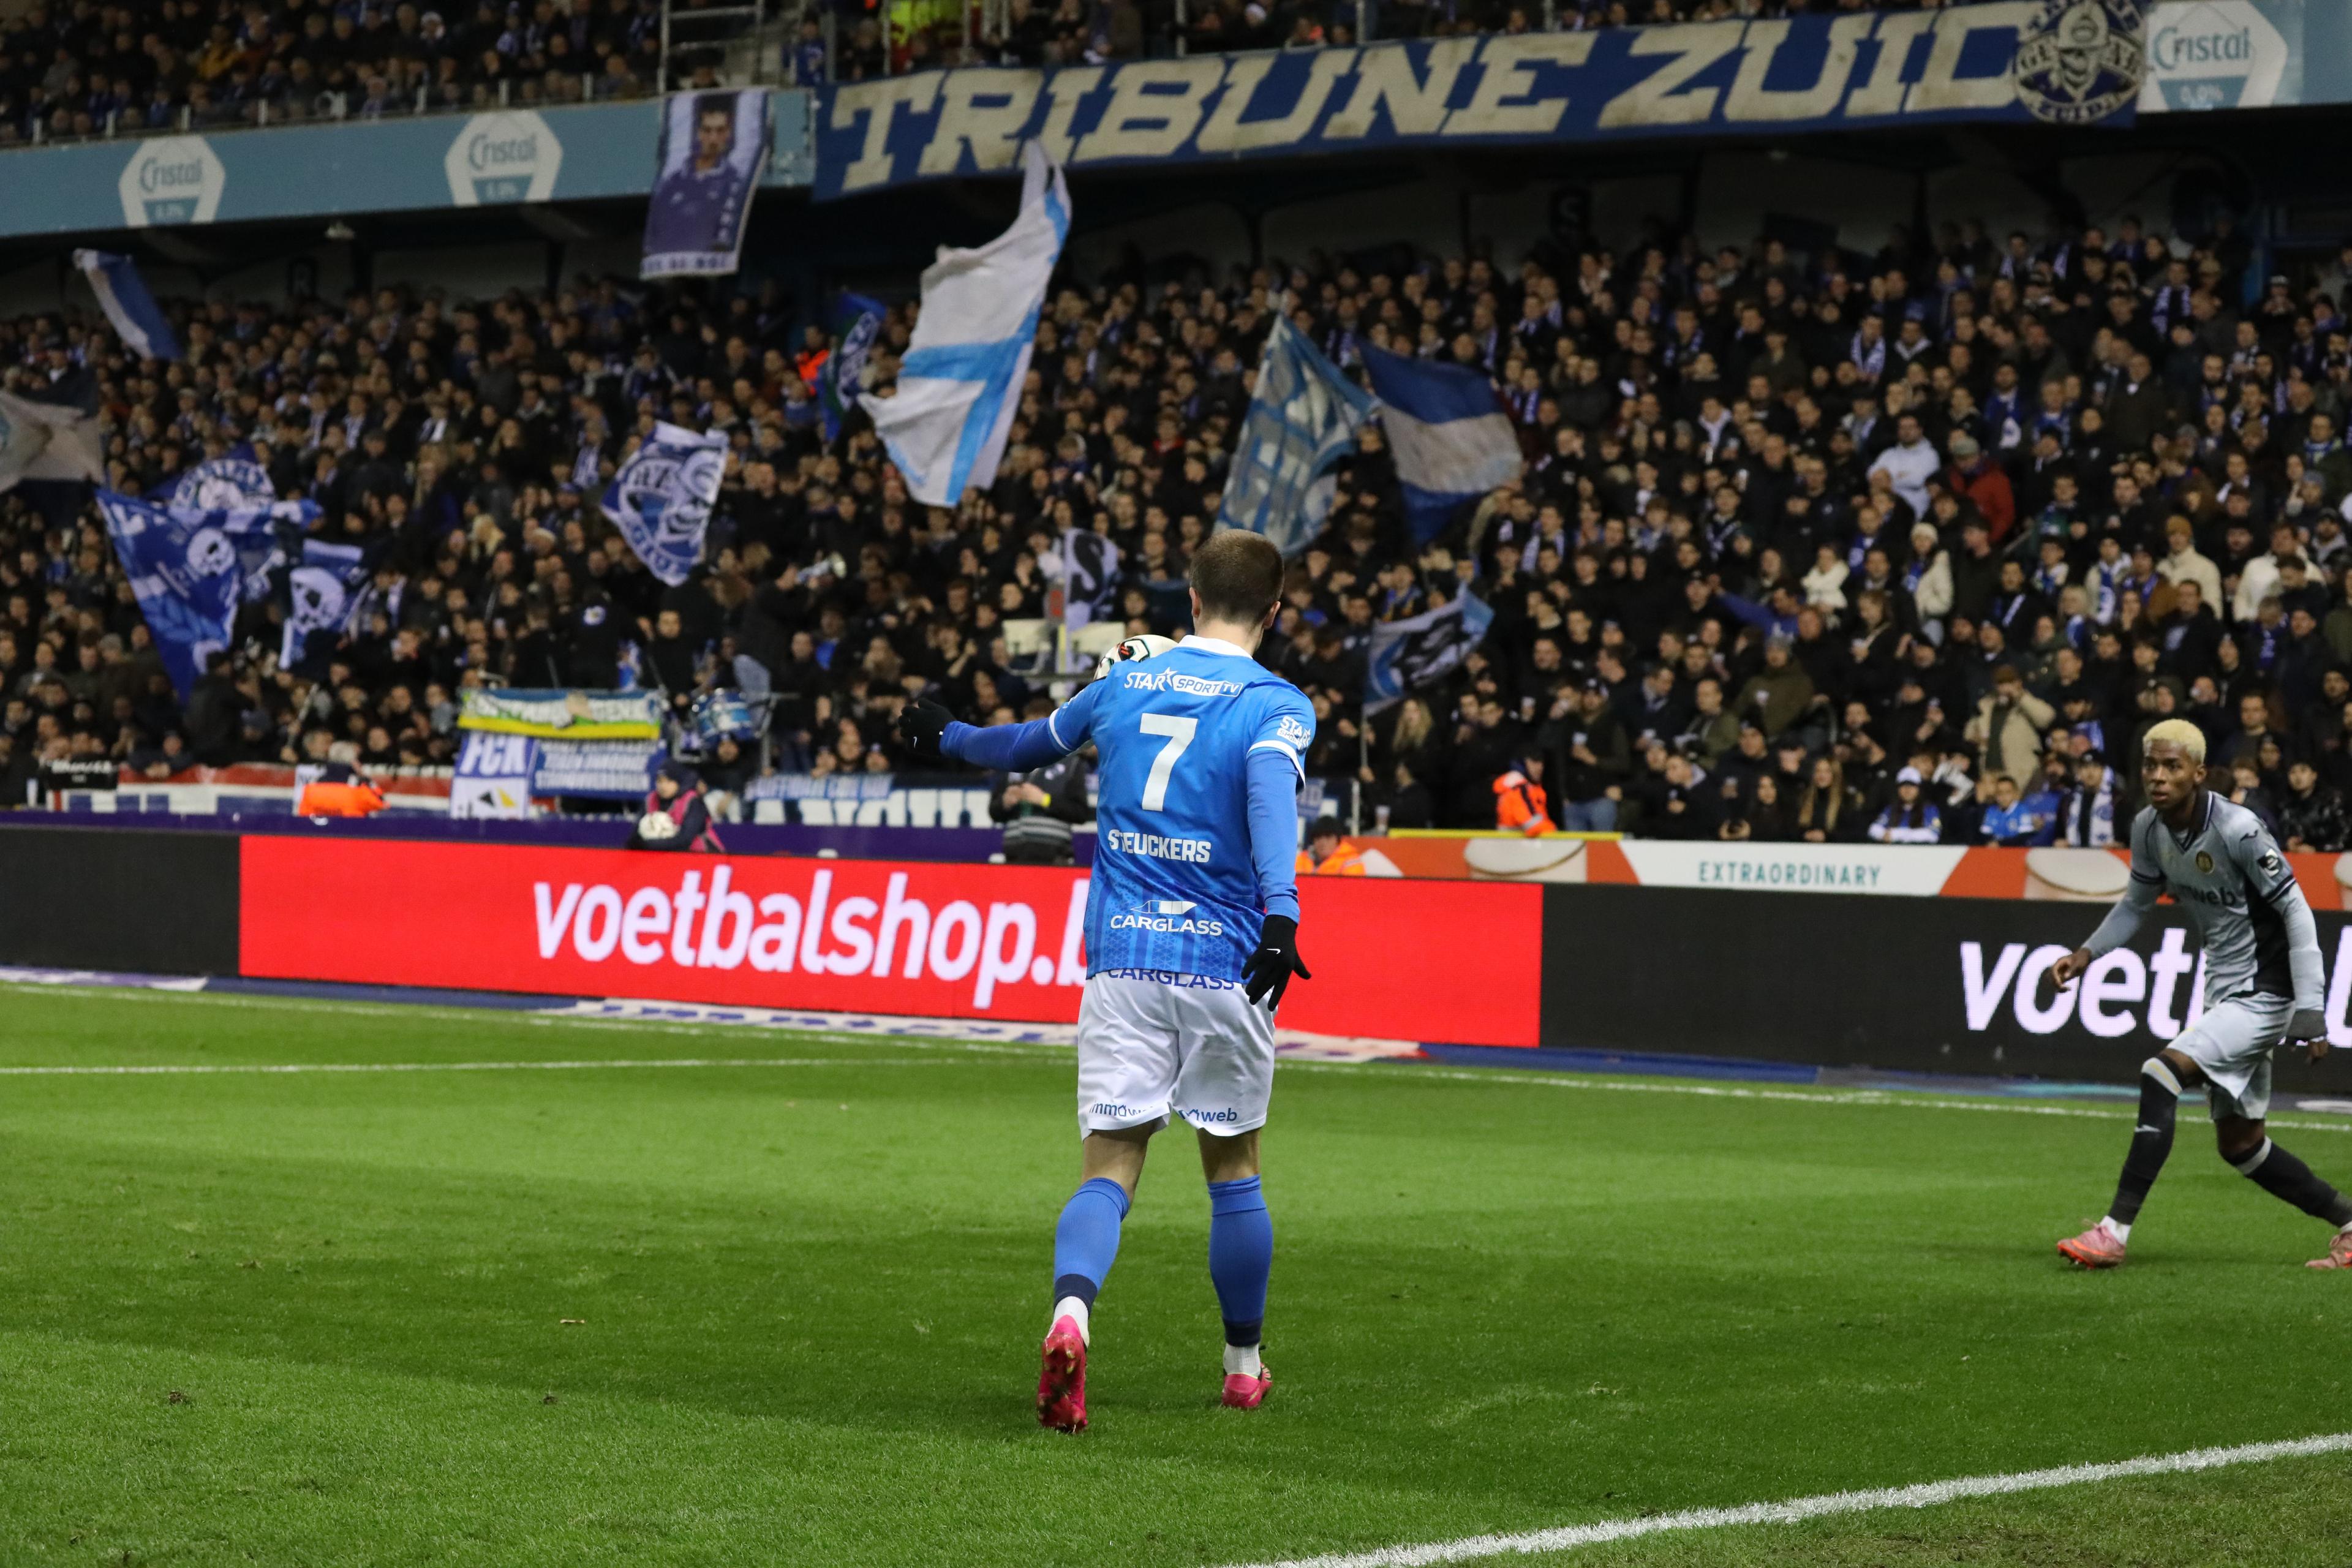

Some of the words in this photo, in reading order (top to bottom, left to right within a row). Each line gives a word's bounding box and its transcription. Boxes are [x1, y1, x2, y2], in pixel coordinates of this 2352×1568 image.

[2152, 26, 2250, 70] Cristal
[832, 31, 1599, 192] TRIBUNE
[1597, 2, 2043, 129] ZUID
[469, 132, 538, 171] Cristal
[140, 156, 203, 193] Cristal
[1124, 671, 1169, 692] STAR
[1176, 678, 1219, 694] SPORT
[1221, 682, 1240, 694] TV
[1139, 712, 1199, 812] 7
[1107, 829, 1212, 863] STEUCKERS
[1698, 861, 1881, 886] EXTRAORDINARY
[1110, 914, 1224, 937] CARGLASS
[1107, 968, 1235, 990] CARGLASS
